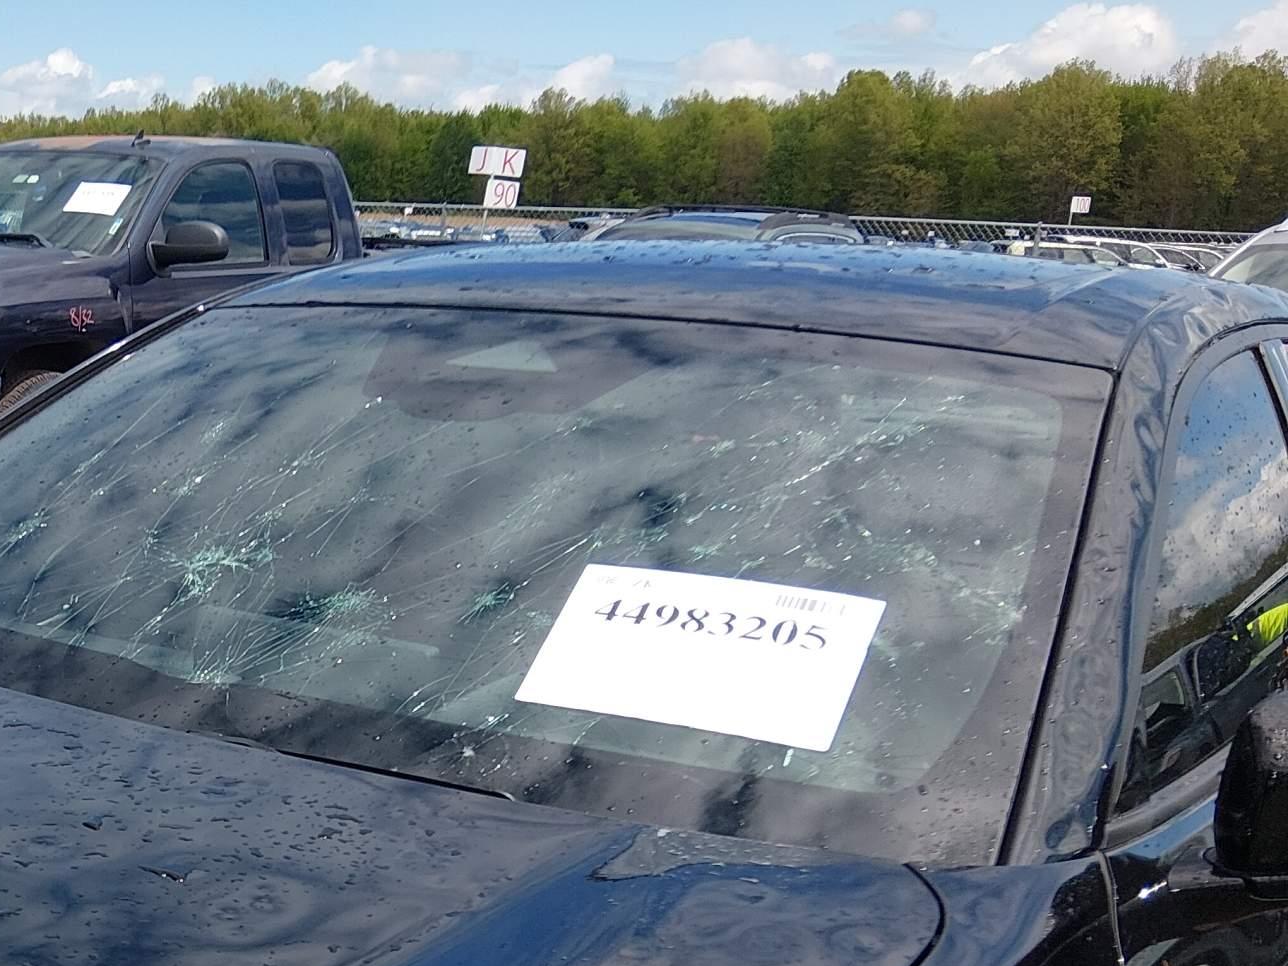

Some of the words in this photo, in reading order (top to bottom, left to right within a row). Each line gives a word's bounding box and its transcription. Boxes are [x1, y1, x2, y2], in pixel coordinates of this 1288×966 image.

[475, 147, 489, 172] J
[501, 149, 520, 175] K
[493, 182, 517, 209] 90
[594, 599, 827, 650] 44983205
